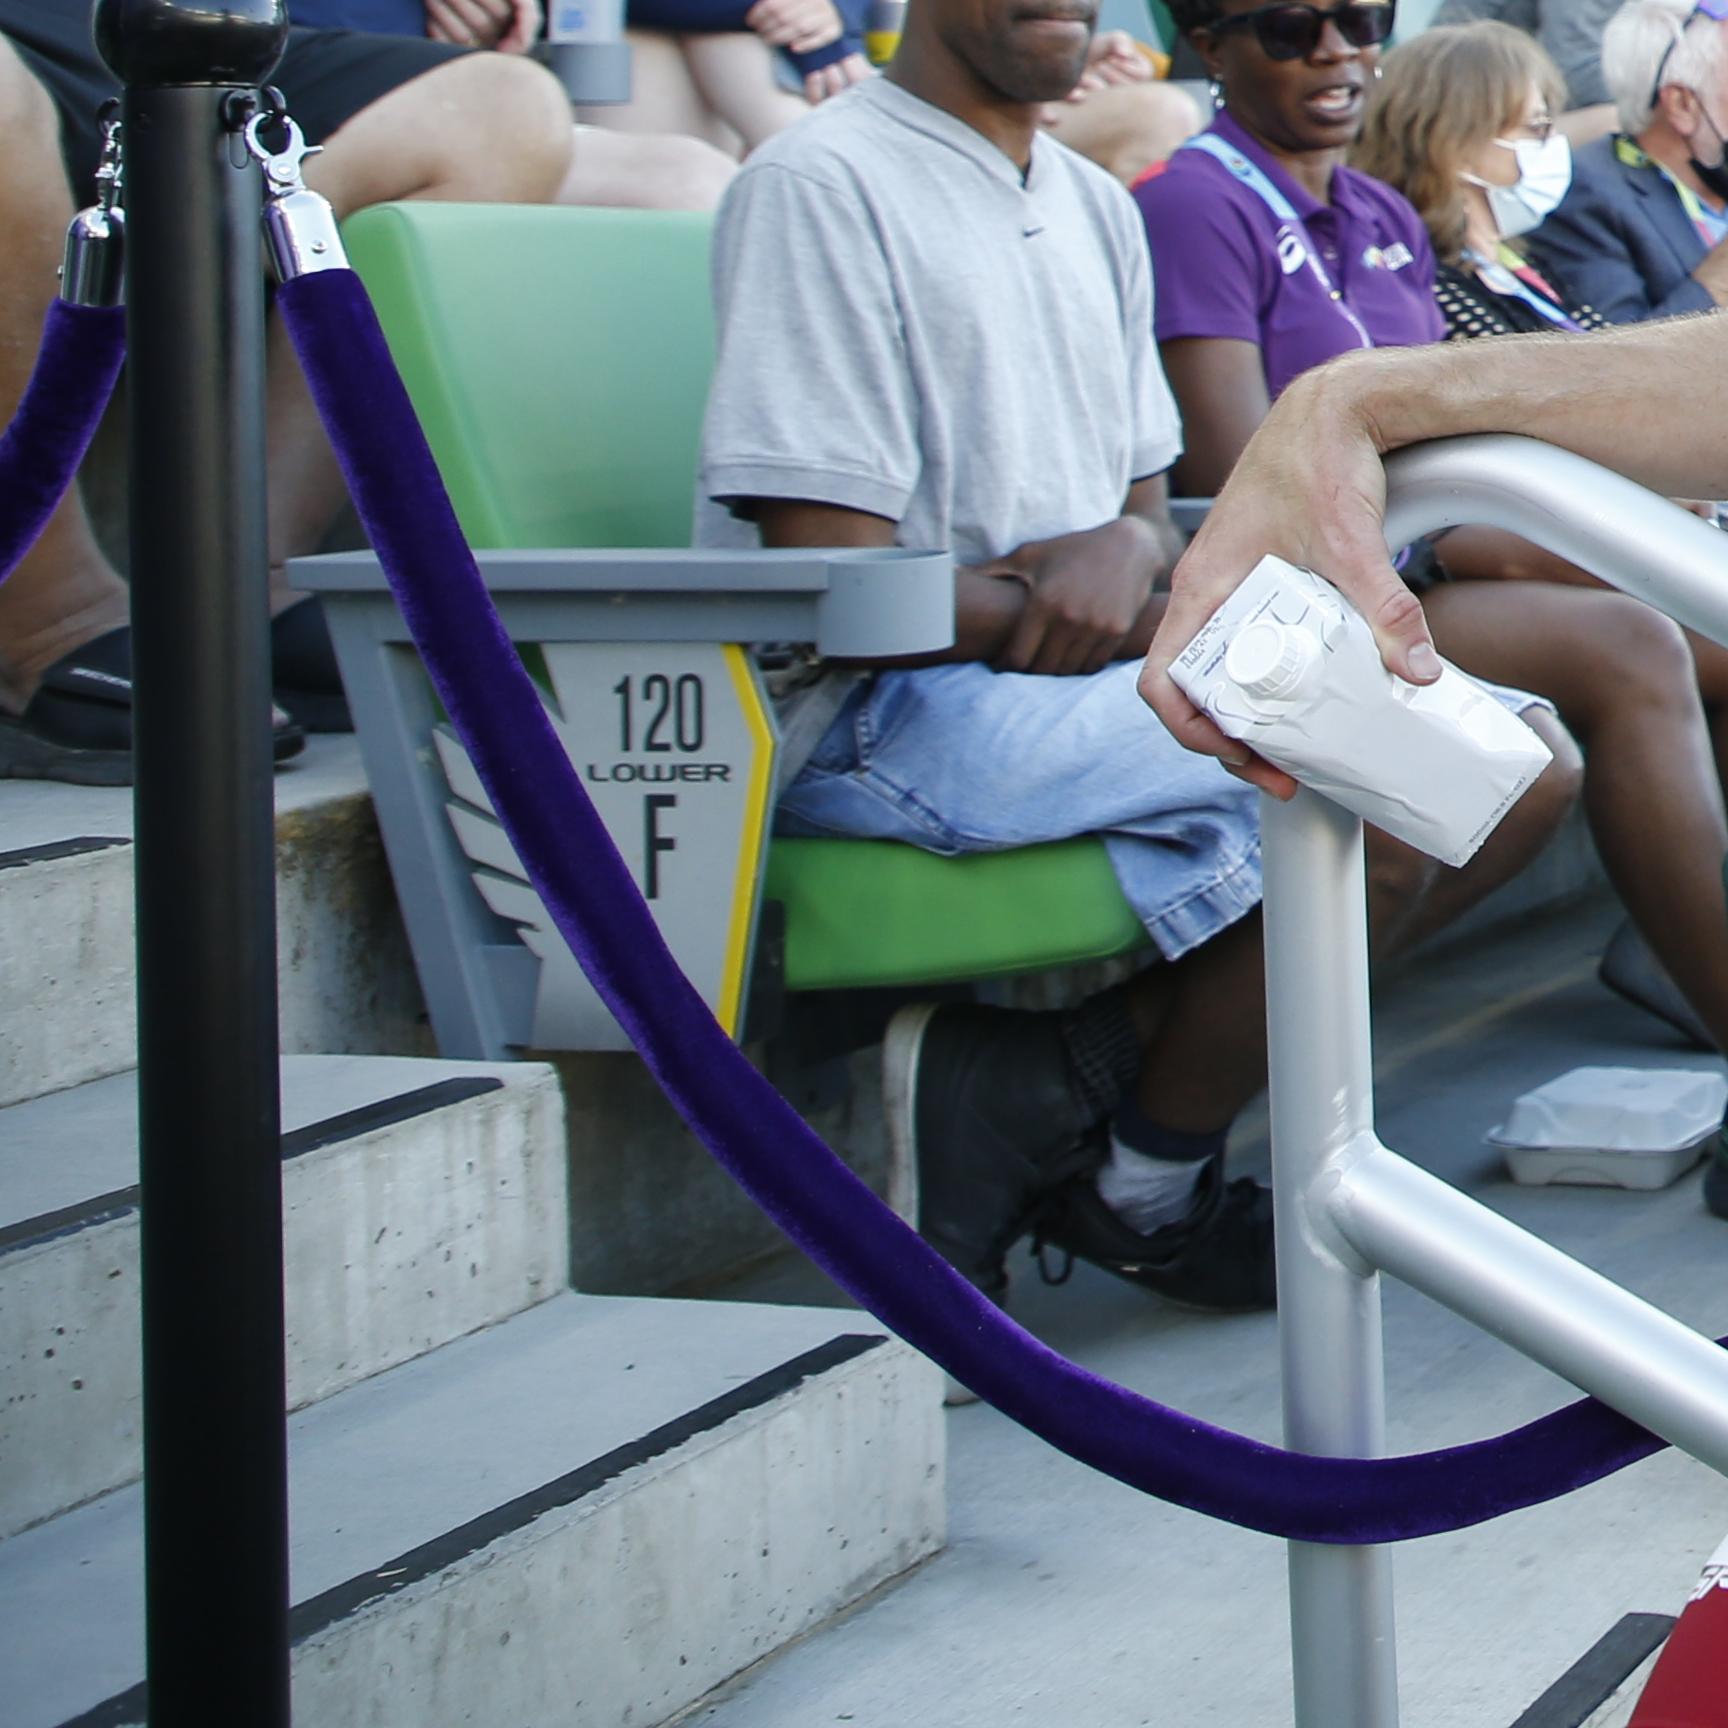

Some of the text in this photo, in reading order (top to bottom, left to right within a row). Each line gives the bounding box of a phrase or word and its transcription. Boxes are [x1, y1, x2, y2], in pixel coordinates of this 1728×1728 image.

[611, 672, 705, 754] 120
[585, 761, 732, 784] LOWER
[642, 793, 677, 901] F
